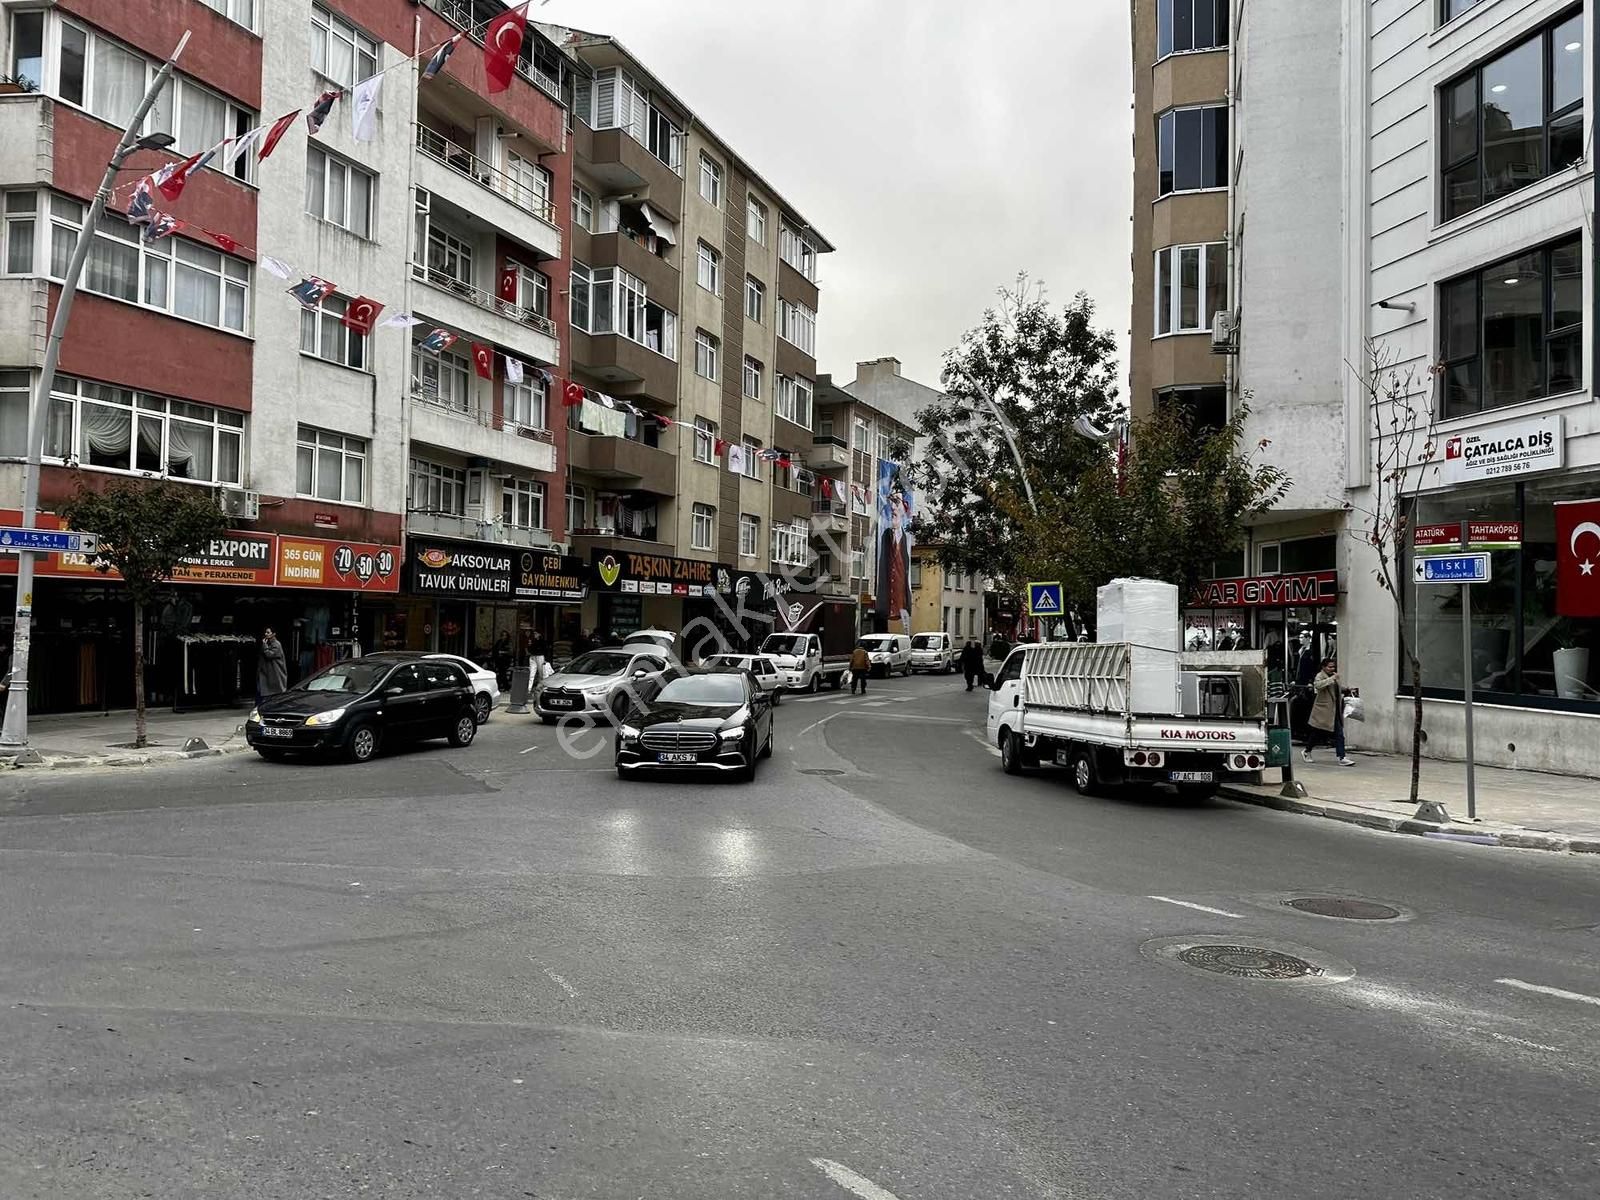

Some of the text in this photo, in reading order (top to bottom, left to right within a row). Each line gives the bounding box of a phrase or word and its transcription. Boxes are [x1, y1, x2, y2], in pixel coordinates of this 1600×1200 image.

[1464, 430, 1553, 461] ÇATALCA DİŞ
[1466, 435, 1481, 444] ÖZEL
[1465, 459, 1478, 467] AĞIZ
[1486, 456, 1495, 464] DİŞ
[1485, 466, 1500, 475] 0212
[1501, 464, 1512, 472] 789
[1415, 528, 1445, 538] ATATÜRK
[1470, 525, 1519, 534] TAHTAKÖPRÜ
[24, 532, 57, 542] İSKİ
[210, 539, 268, 559] EXPORT
[284, 549, 322, 561] 365 GÜN
[210, 558, 235, 567] ERKEK
[451, 553, 511, 571] AKSOYLAR
[542, 556, 561, 572] ÇEBİ
[629, 554, 671, 580] TAŞKIN
[1440, 559, 1467, 571] İSKİ
[205, 570, 254, 580] PERAKENDE
[284, 564, 320, 579] İNDİRİM
[419, 573, 511, 593] TAVUK ÜRÜNLERİ
[521, 573, 580, 589] GAYRİMENKUL
[1160, 729, 1236, 741] KIA MOTORS
[672, 753, 687, 761] AKS
[1172, 771, 1180, 781] 17
[1183, 772, 1195, 781] ACT
